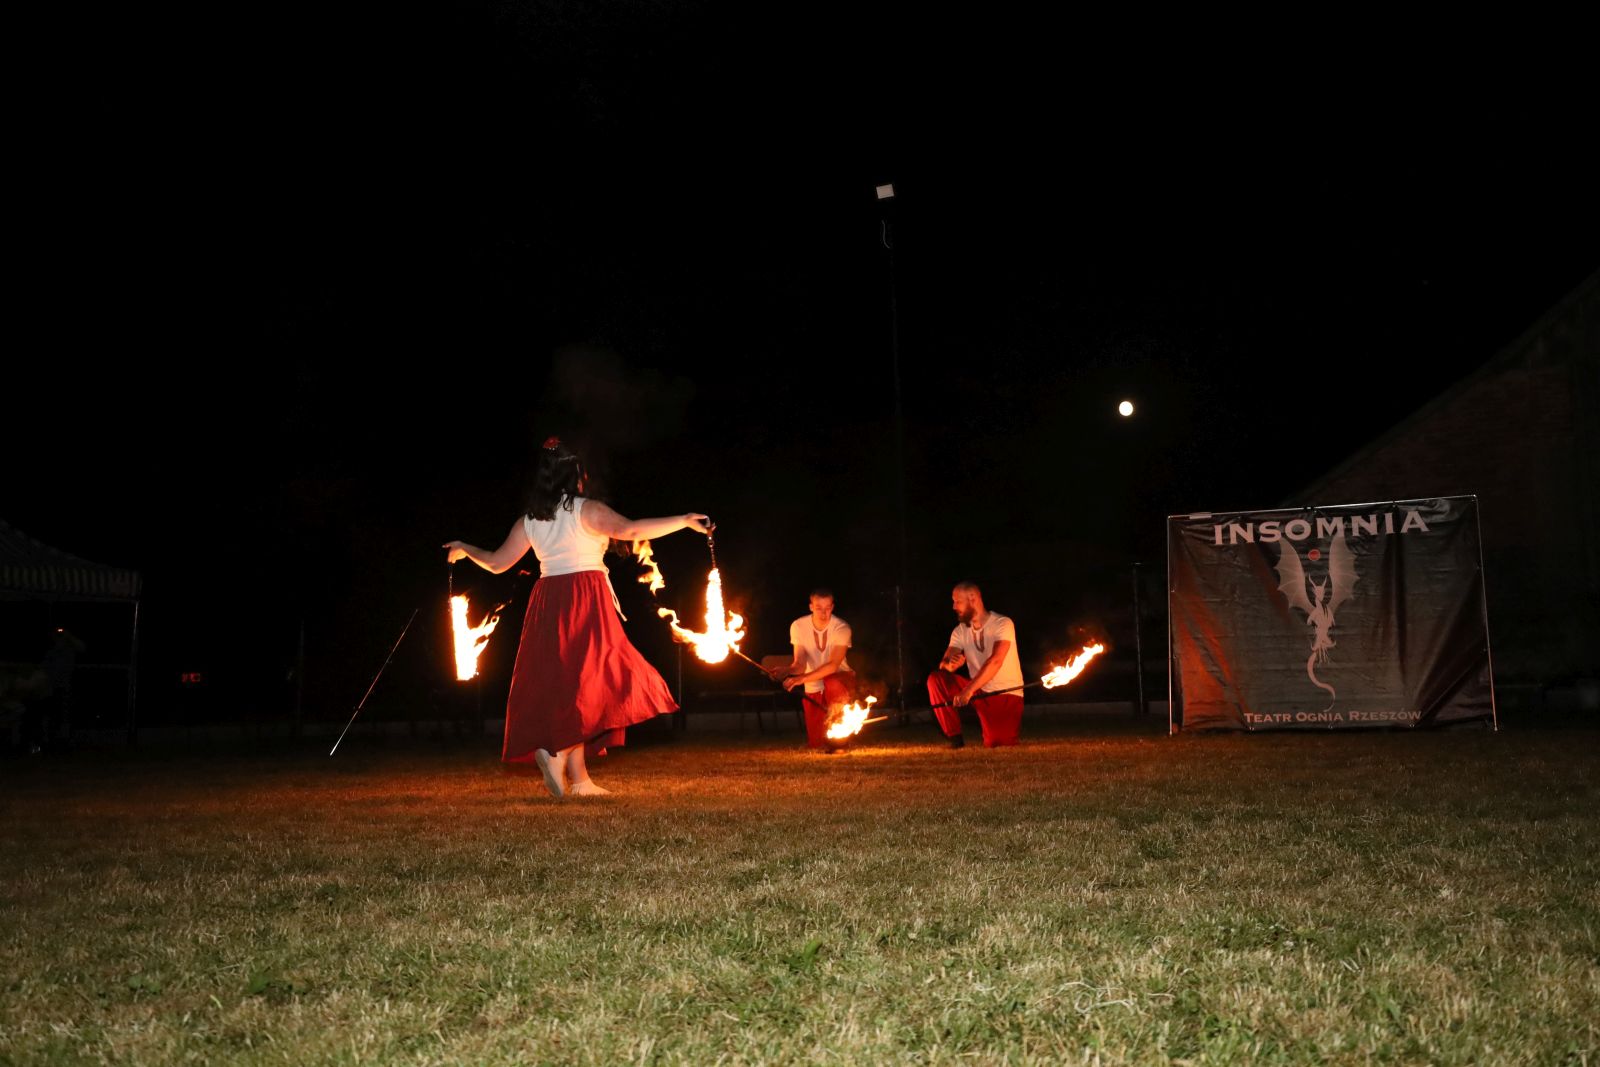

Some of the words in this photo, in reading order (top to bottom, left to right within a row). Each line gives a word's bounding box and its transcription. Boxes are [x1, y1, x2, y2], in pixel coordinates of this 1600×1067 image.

[1214, 511, 1430, 545] INSOMNIA
[1244, 712, 1292, 723] TEATR
[1295, 712, 1344, 722] OGNIA
